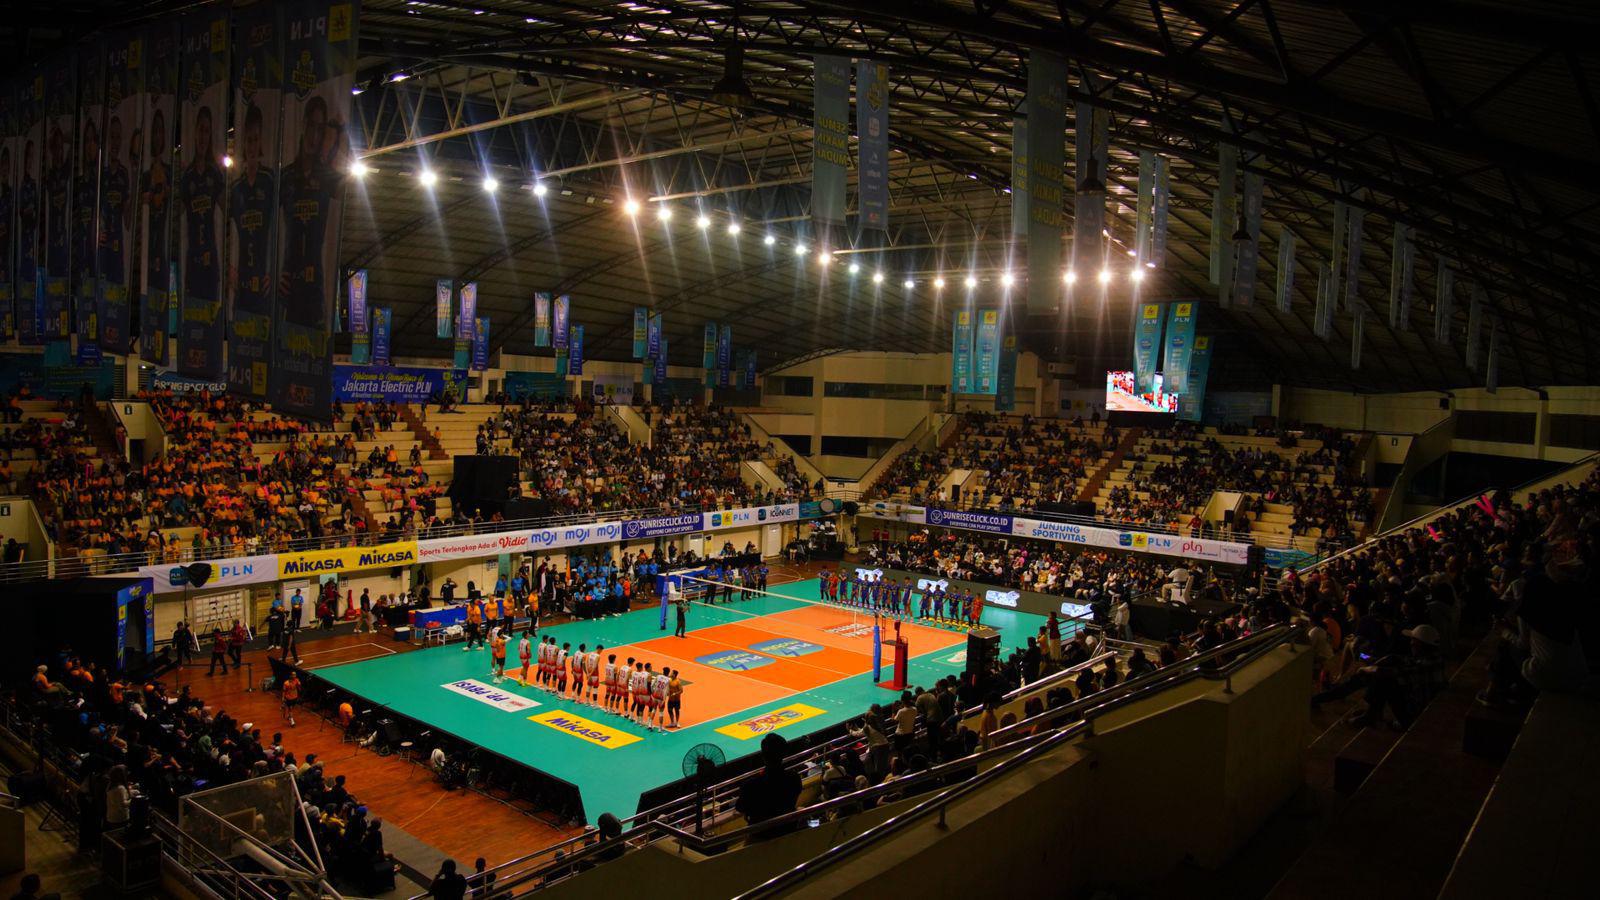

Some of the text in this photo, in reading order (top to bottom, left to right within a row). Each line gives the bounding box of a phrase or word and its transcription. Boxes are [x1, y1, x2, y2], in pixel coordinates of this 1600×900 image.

[342, 379, 432, 394] Jakarta Electric PLN
[640, 515, 700, 529] SUNRISECLICK.CO.ID
[733, 513, 749, 521] PLN
[942, 511, 1008, 526] SUNRISECLICK.CO.ID
[1039, 522, 1080, 534] JUNJUNG
[1032, 529, 1087, 543] SPORTIVITAS
[1148, 537, 1171, 547] PLN
[442, 544, 477, 553] Terlengkap
[498, 536, 528, 548] Vidio
[1183, 541, 1203, 553] pln
[222, 564, 253, 577] PLN
[451, 681, 492, 695] PBVSI
